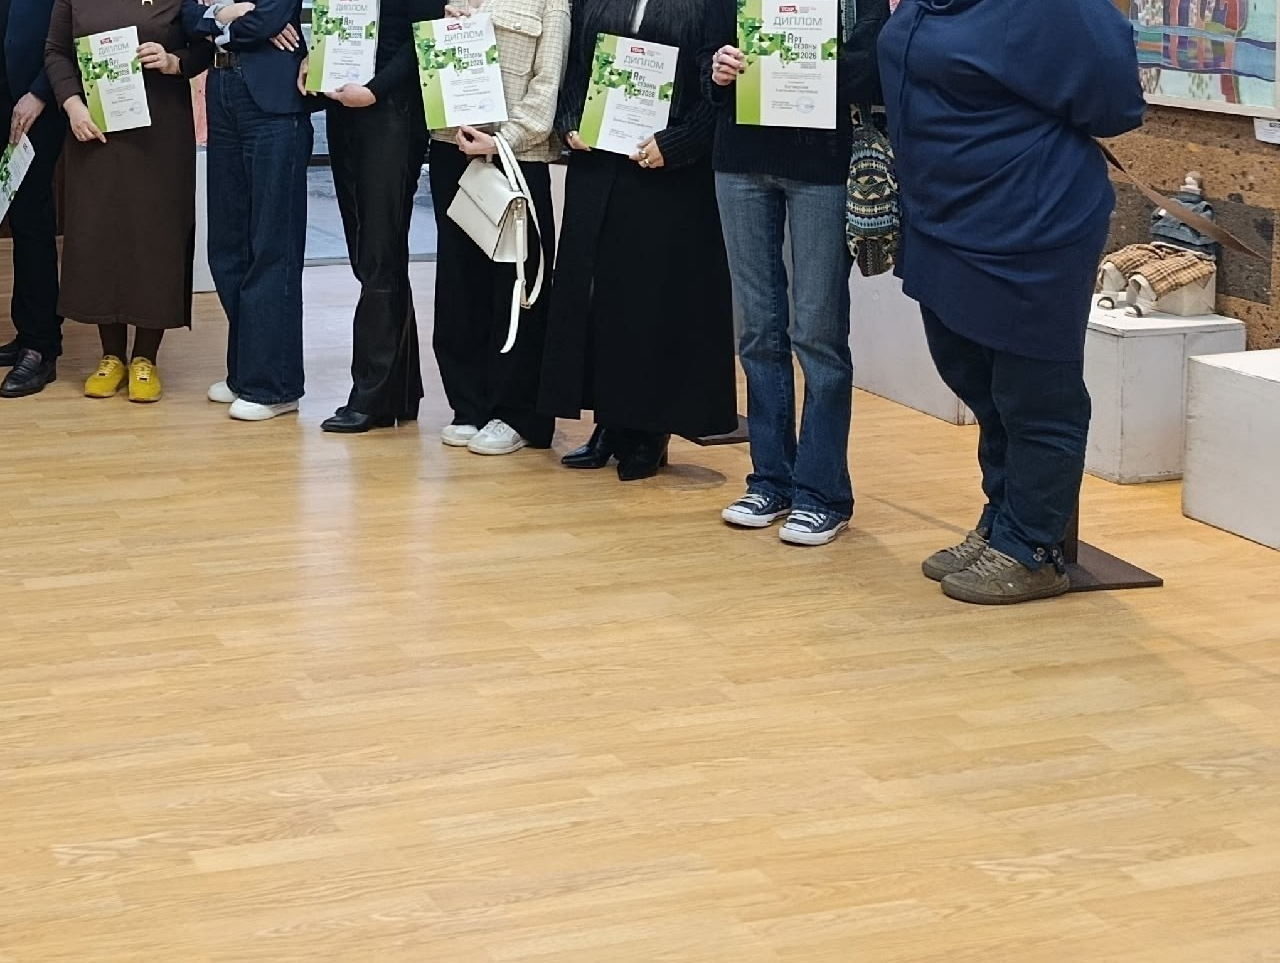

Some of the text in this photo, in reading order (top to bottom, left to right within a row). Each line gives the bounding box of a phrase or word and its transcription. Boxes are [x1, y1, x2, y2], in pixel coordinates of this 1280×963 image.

[335, 3, 368, 12] ДИПЛОМ
[773, 16, 823, 26] ДИПЛОМ
[444, 30, 484, 43] ДИПЛОМ
[98, 42, 130, 55] ДИПЛОМ
[800, 51, 817, 60] 2026
[623, 55, 665, 70] ДИПЛОМ
